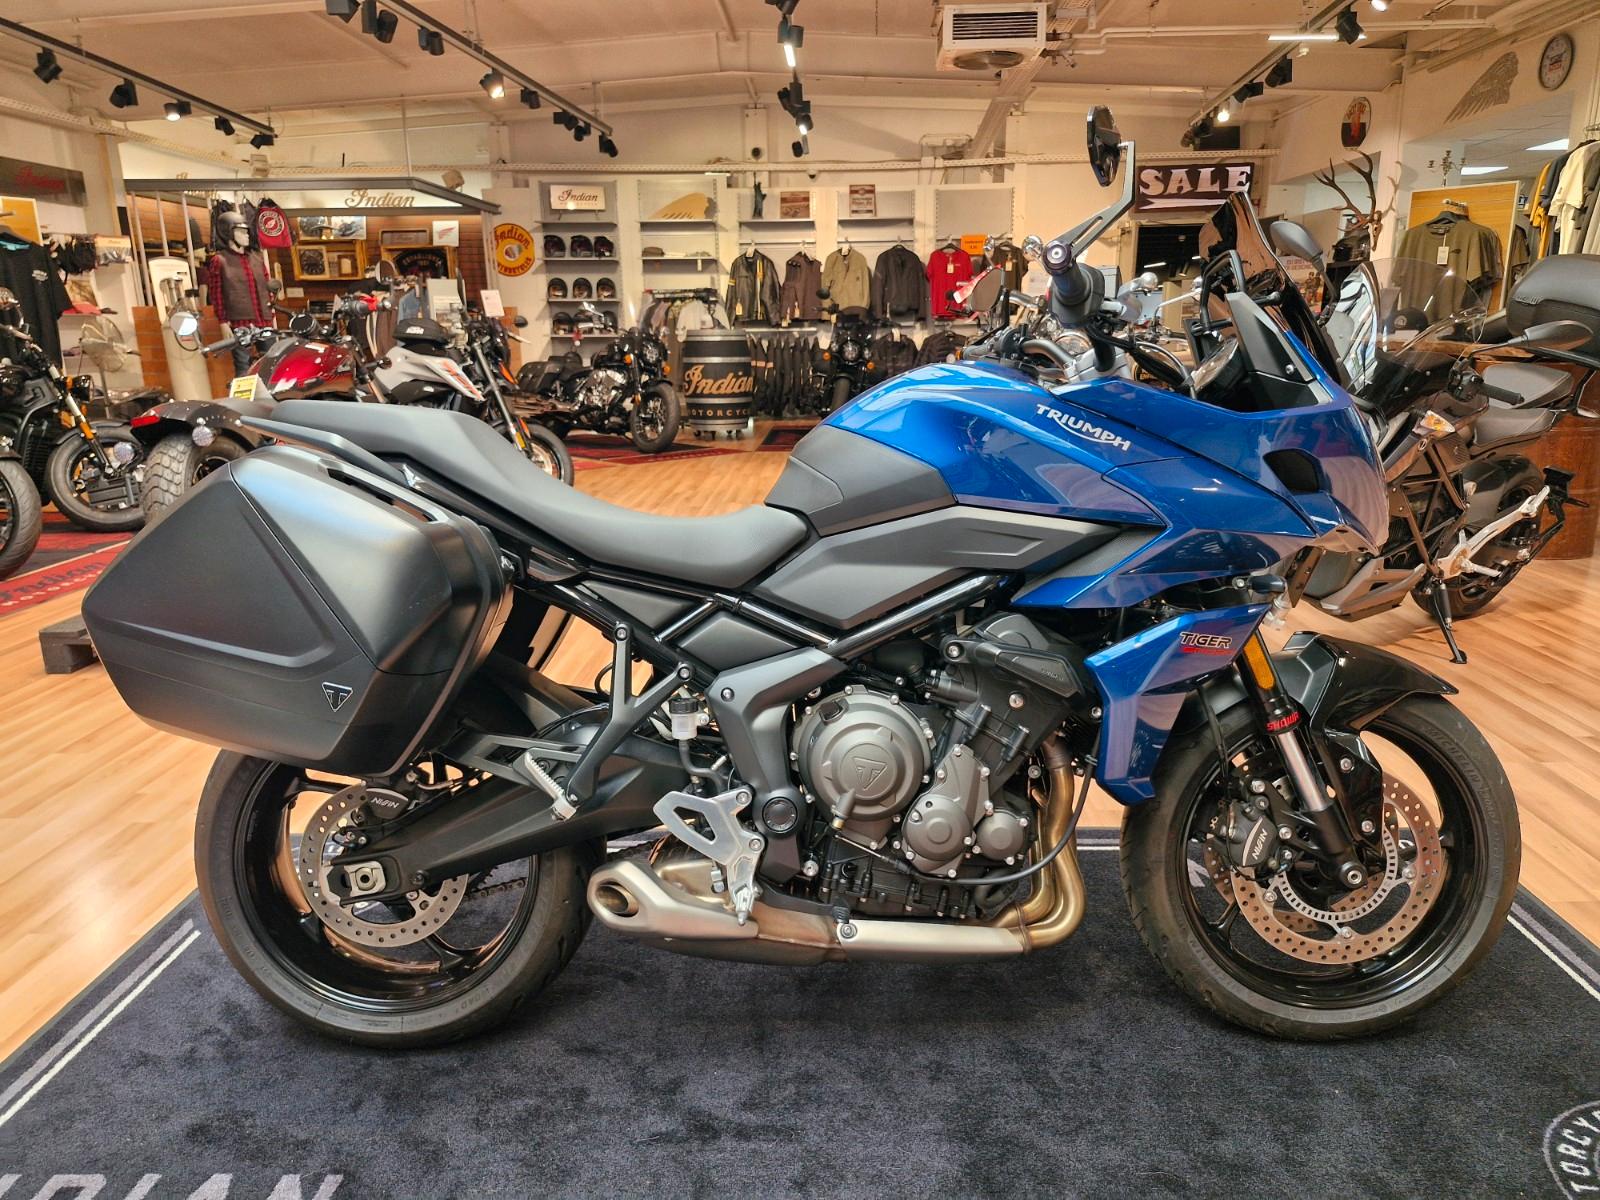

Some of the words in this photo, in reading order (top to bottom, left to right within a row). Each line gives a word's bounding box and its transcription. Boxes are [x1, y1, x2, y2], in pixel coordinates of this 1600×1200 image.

[1139, 166, 1251, 195] SALE
[344, 188, 415, 208] Indian
[558, 189, 598, 202] Indian
[683, 364, 754, 396] Indian
[1036, 404, 1132, 452] TRIUMPH
[1180, 631, 1233, 649] TIGER
[1251, 828, 1268, 860] NISSIN
